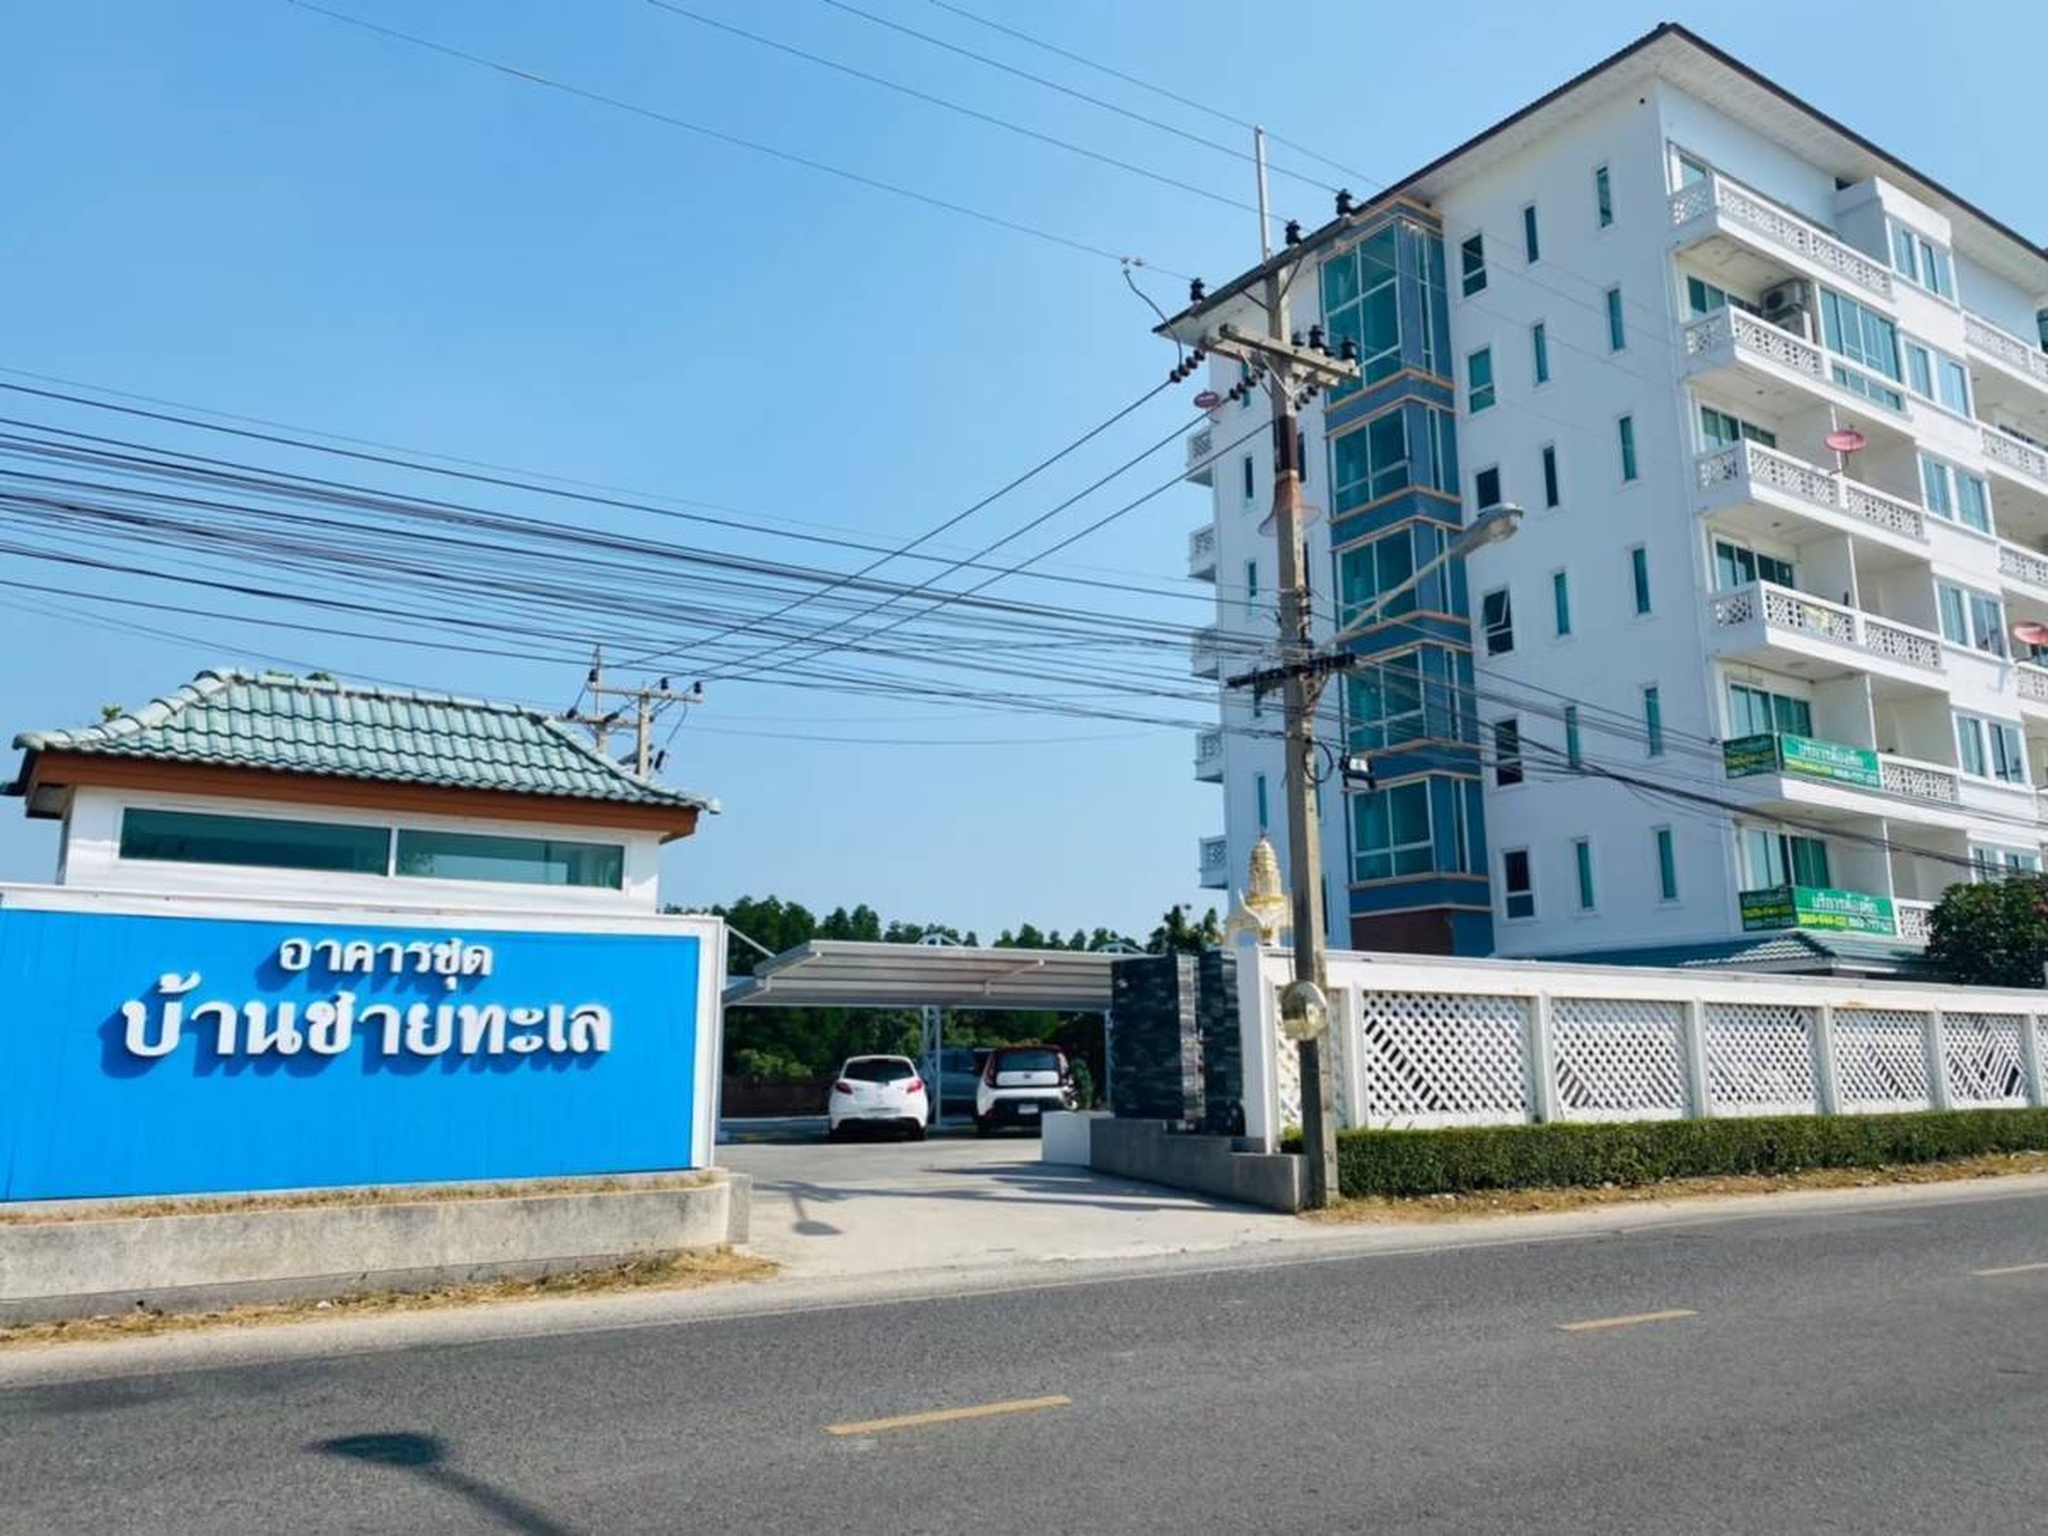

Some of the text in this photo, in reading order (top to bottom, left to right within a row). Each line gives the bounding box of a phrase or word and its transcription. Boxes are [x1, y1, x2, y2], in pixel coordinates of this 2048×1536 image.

[279, 937, 493, 990] อาคารชุด
[121, 971, 612, 1057] บ้านชายทะเล
